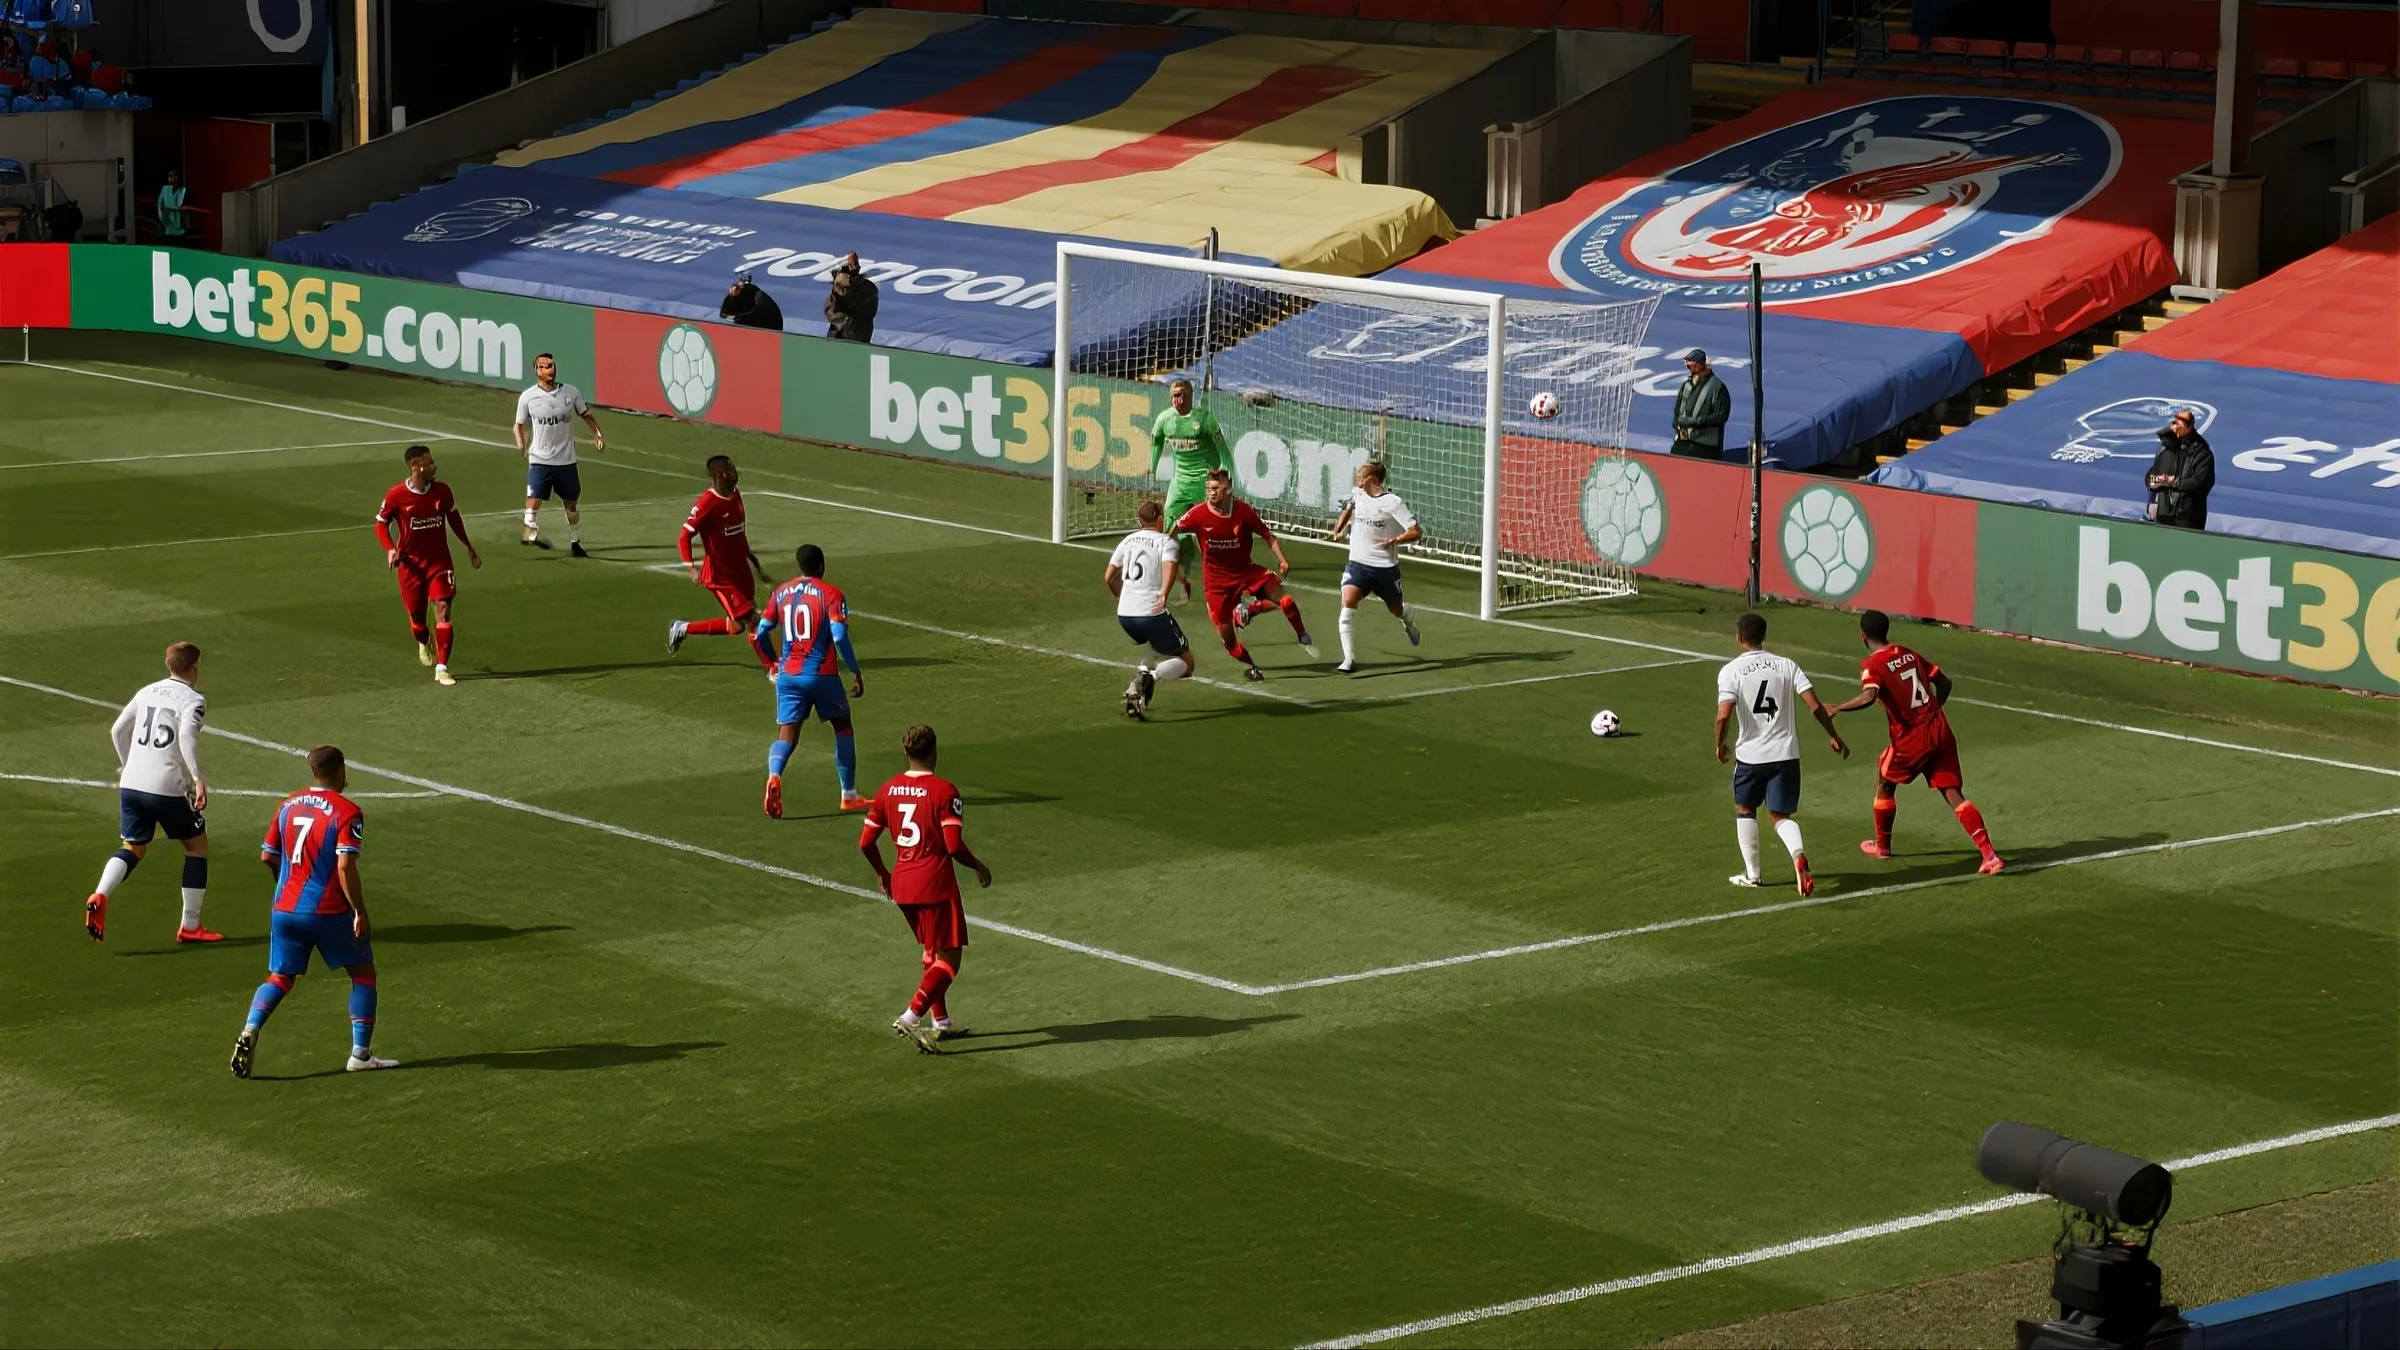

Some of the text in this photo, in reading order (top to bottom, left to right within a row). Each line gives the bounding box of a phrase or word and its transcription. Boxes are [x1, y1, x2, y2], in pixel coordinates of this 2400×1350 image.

[152, 250, 524, 380] bet365.com
[783, 603, 811, 642] 10
[1752, 679, 1779, 723] 4
[291, 816, 315, 866] 7
[897, 803, 921, 848] 3
